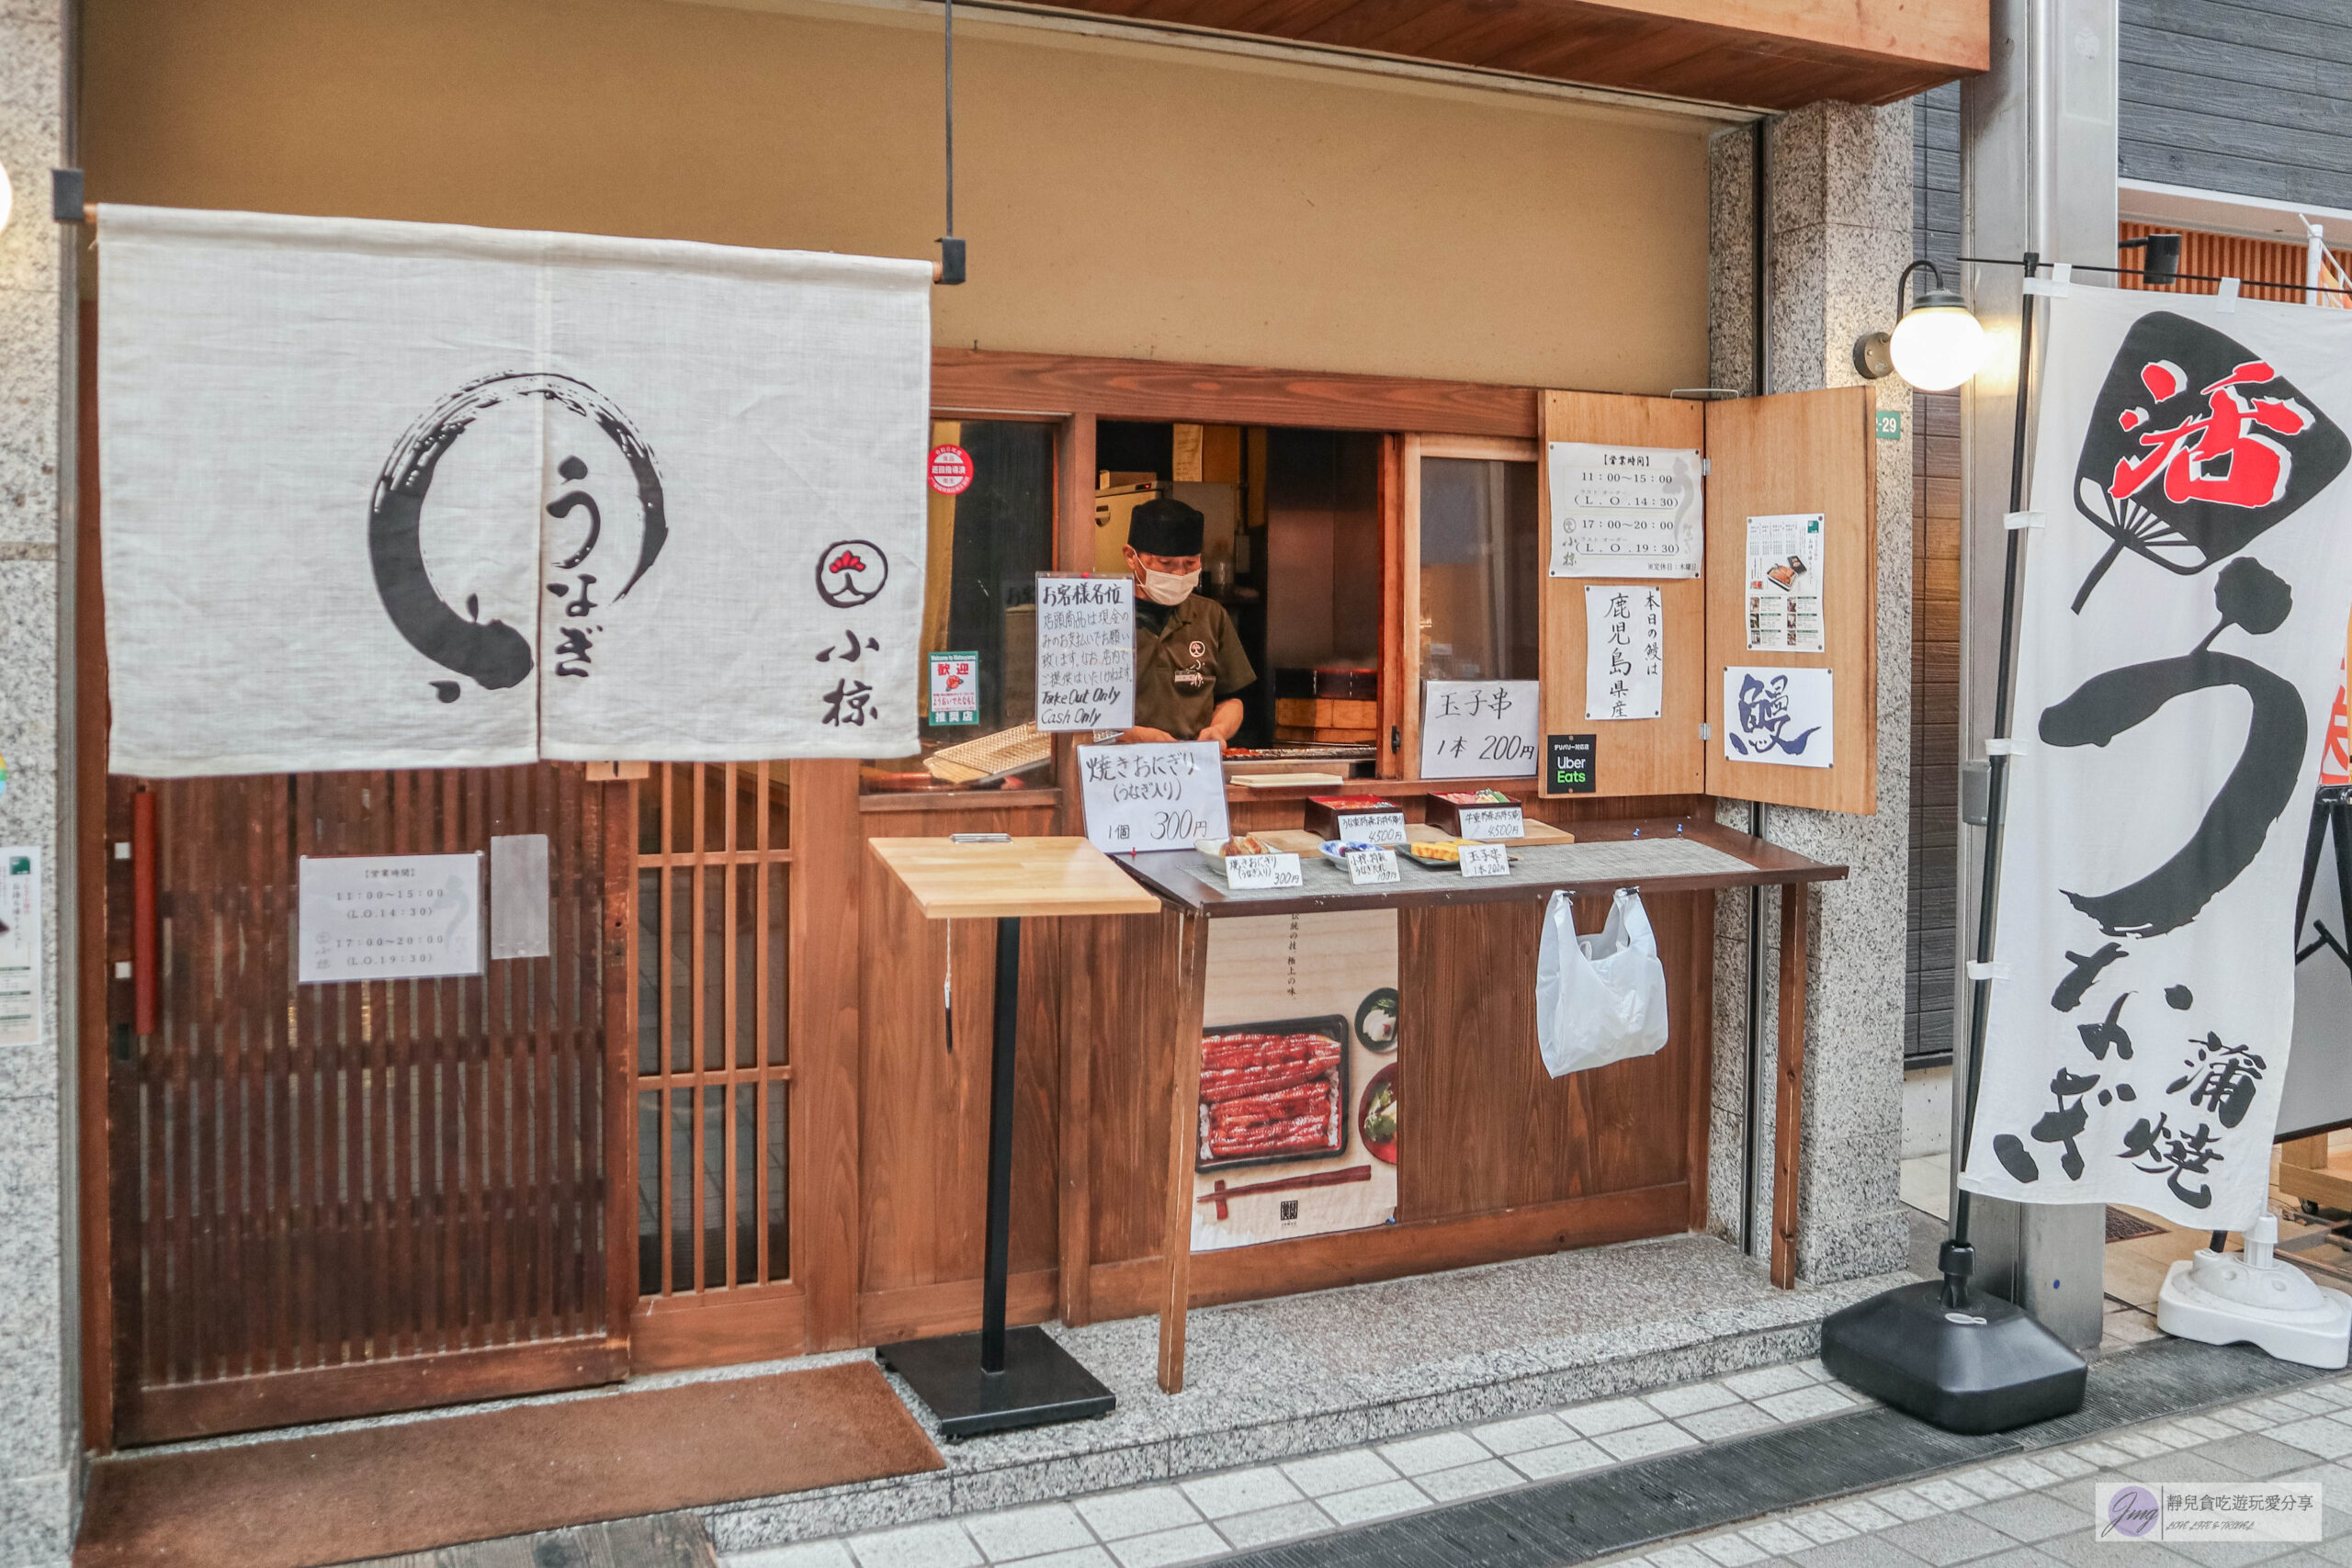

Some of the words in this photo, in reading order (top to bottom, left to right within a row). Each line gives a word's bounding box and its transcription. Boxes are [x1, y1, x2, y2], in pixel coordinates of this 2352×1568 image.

[1876, 416, 1896, 433] -29
[2109, 359, 2316, 509] 活
[546, 455, 604, 678] うなぎ
[1043, 582, 1124, 606] お客様各位
[1044, 608, 1129, 629] 店頭商品は現金の
[1644, 591, 1662, 676] 本日の鰻は
[1603, 592, 1632, 718] 鹿児島県産
[815, 629, 880, 727] 小椋
[937, 662, 969, 676] 歓迎
[1042, 691, 1067, 706] Take
[1069, 689, 1088, 705] Out
[1092, 686, 1121, 705] Only
[1435, 687, 1512, 720] 玉子串
[1041, 708, 1070, 725] Cash
[1074, 707, 1102, 727] Only
[1437, 736, 1467, 759] 1本
[1478, 736, 1535, 761] 200円
[1086, 751, 1195, 783] 焼きおにぎり
[1557, 756, 1587, 769] Uber
[1557, 770, 1586, 783] Eats
[1113, 779, 1182, 803] (うなぎ入り)
[1108, 824, 1130, 840] 1個
[1149, 809, 1207, 840] 300円
[1273, 872, 1299, 885] 300円
[1993, 557, 2308, 1183] うなぎ
[2116, 1031, 2267, 1210] 蒲焼
